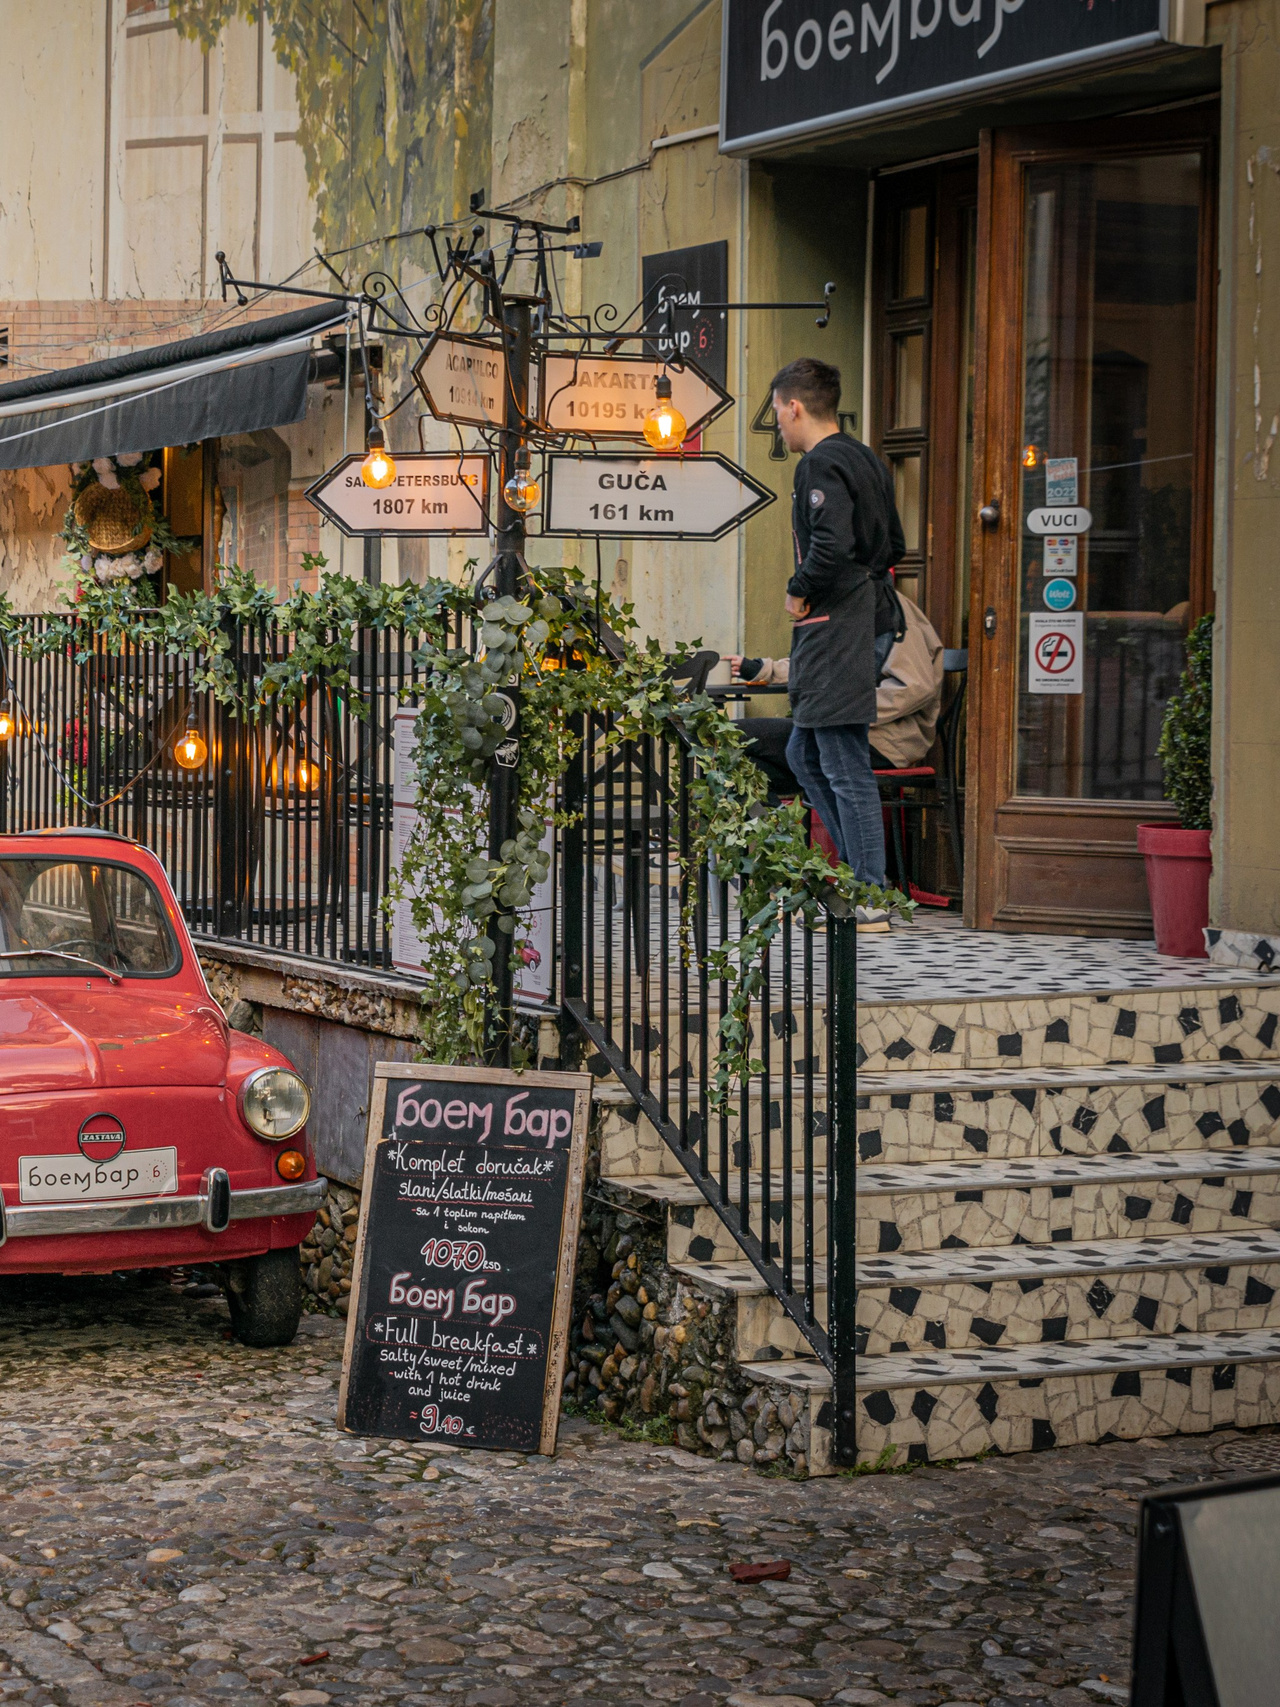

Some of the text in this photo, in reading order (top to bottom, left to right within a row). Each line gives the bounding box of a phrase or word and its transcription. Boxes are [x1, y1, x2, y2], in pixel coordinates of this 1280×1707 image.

[445, 353, 499, 380] ACAPULCO
[566, 400, 627, 419] 10195
[598, 470, 668, 491] GUČA
[1047, 487, 1075, 498] 2022
[373, 498, 448, 515] 1807 km
[589, 503, 674, 522] 161 km
[1041, 514, 1077, 527] VUCI
[395, 1084, 573, 1149] боем бар
[82, 1133, 122, 1141] ZASTAVA
[29, 1163, 139, 1193] боембар
[433, 1206, 440, 1217] 1
[443, 1207, 478, 1221] toplim
[481, 1209, 526, 1224] napitkom
[444, 1220, 490, 1234] i sokom
[389, 1271, 517, 1327] боем бар
[426, 1370, 435, 1384] 1
[439, 1372, 462, 1386] hot
[466, 1376, 501, 1391] drink
[408, 1385, 471, 1402] and juice
